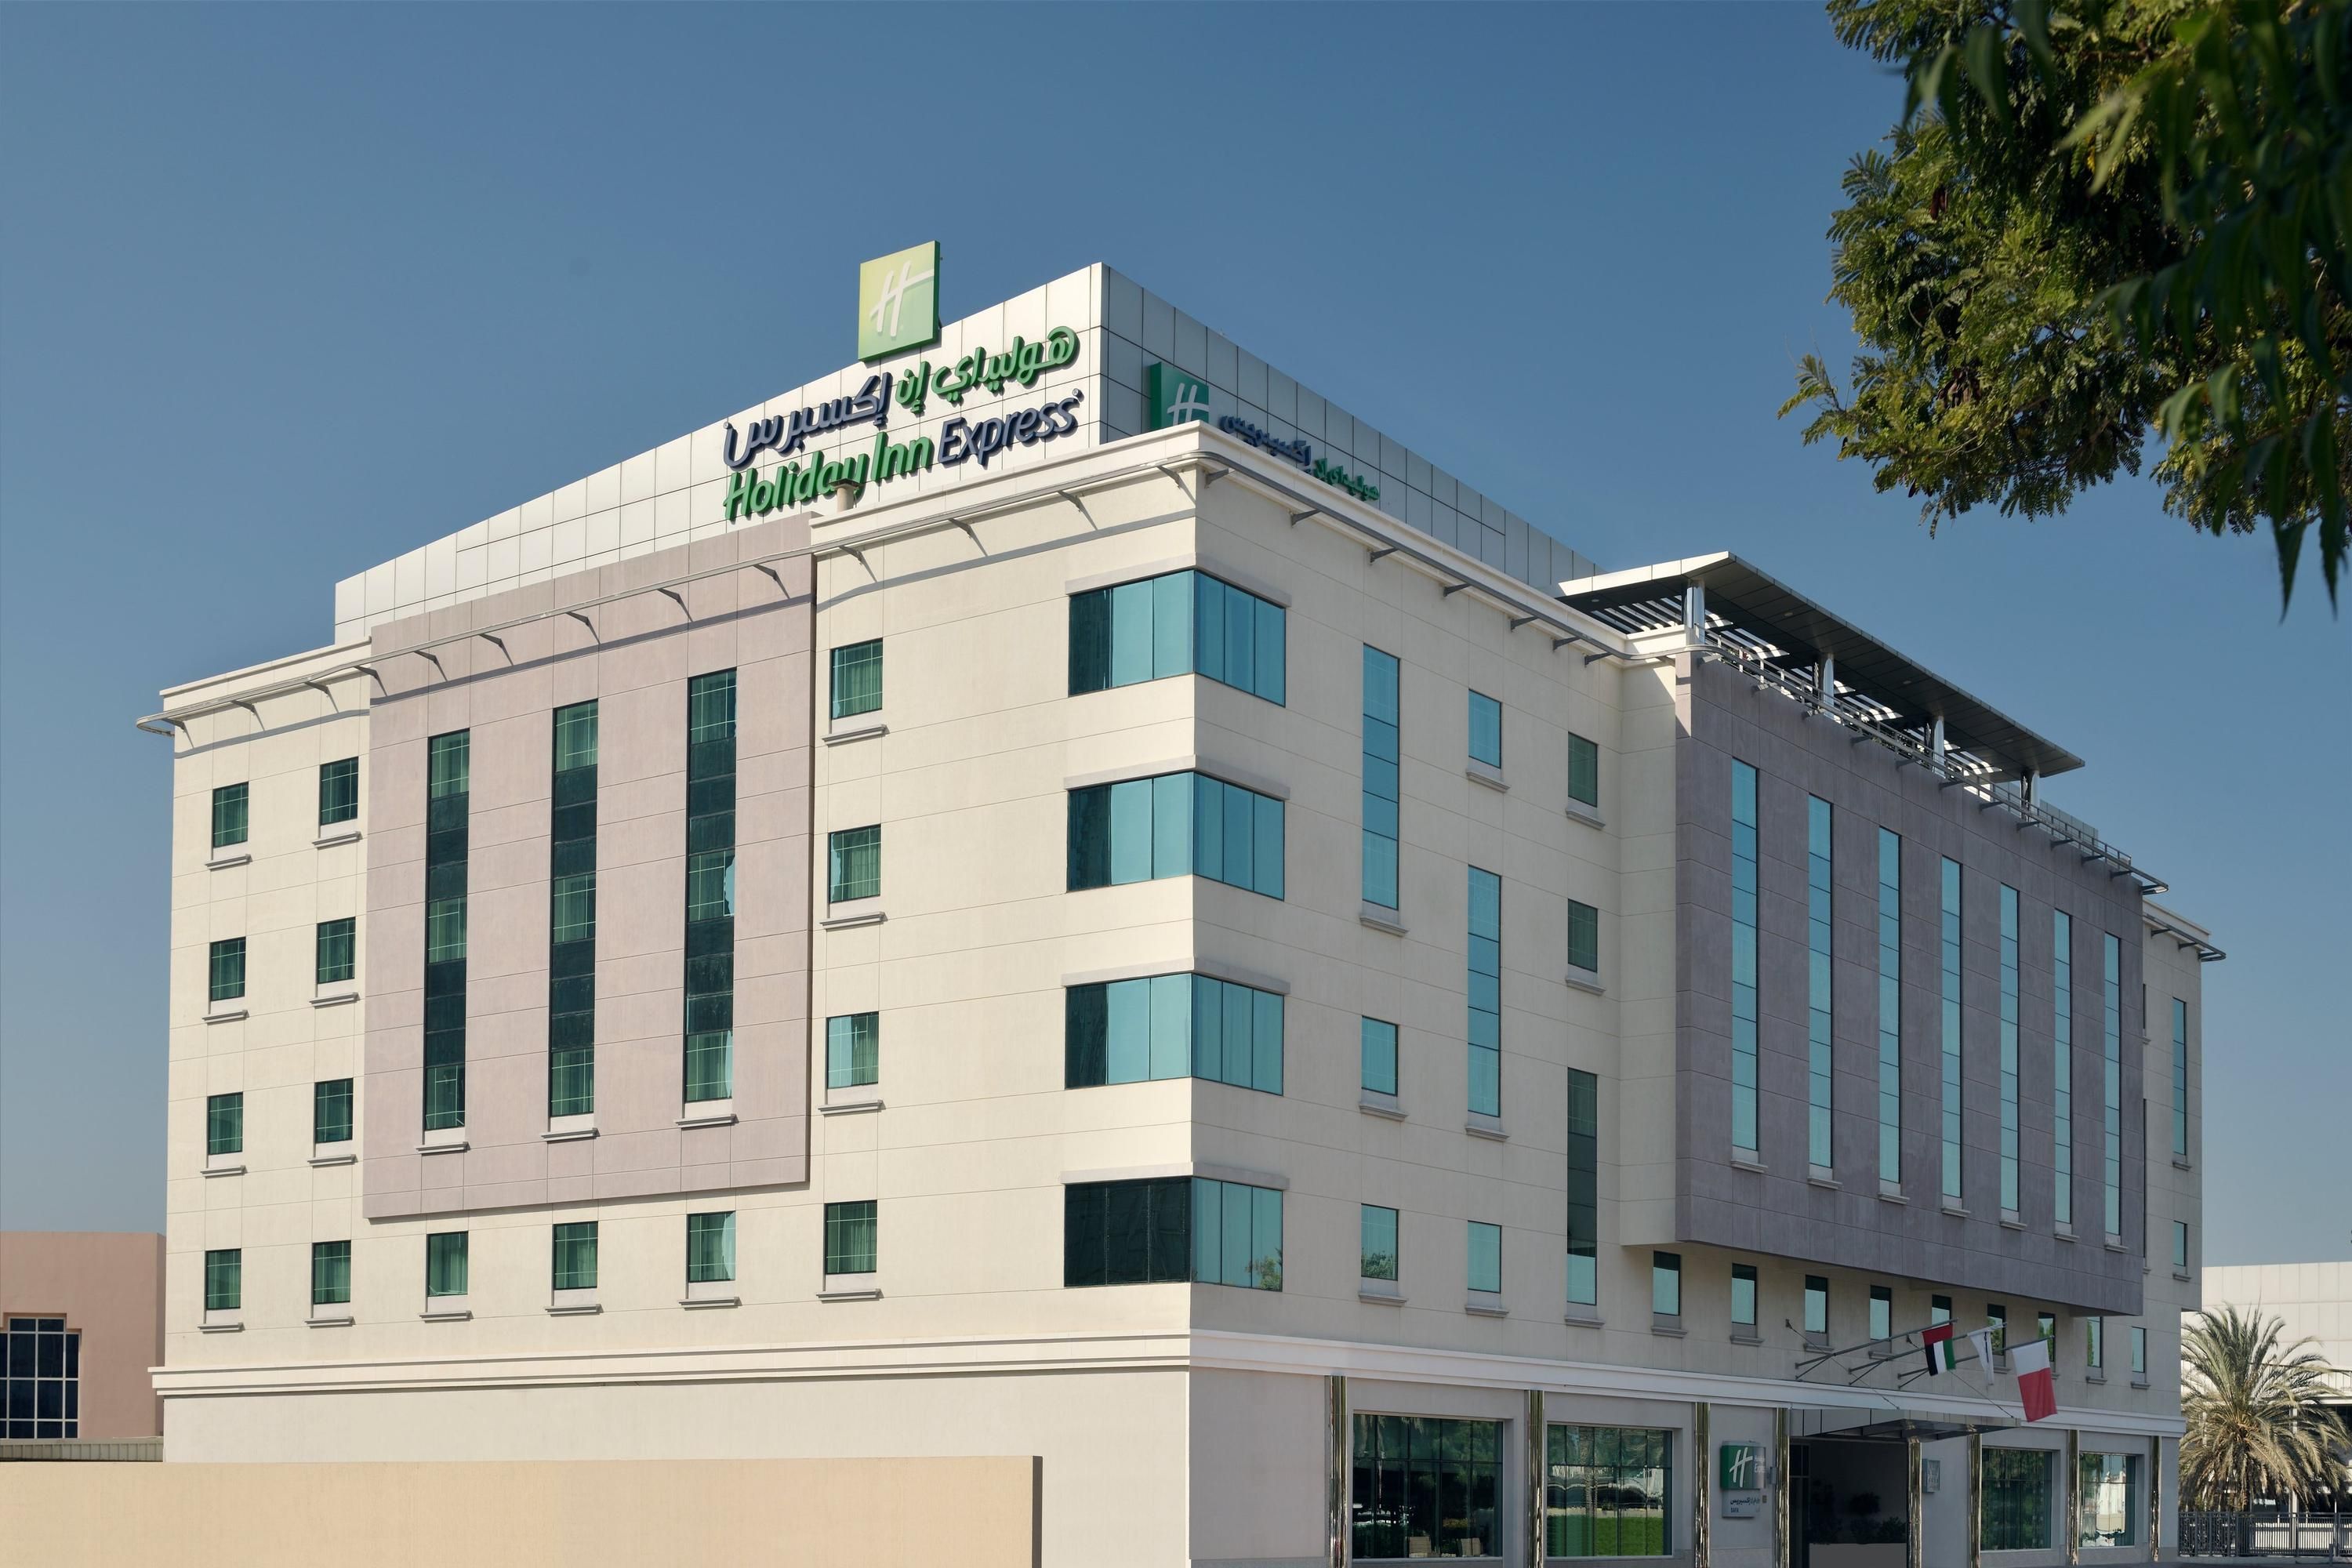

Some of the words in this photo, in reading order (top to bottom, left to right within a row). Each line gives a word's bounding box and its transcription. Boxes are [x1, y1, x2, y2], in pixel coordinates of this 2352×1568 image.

[895, 361, 931, 412] إن
[931, 326, 1080, 403] هوليداي
[724, 372, 893, 468] إكسبرس
[724, 451, 869, 521] Holiday
[871, 432, 935, 485] Inn
[939, 396, 1081, 466] Express
